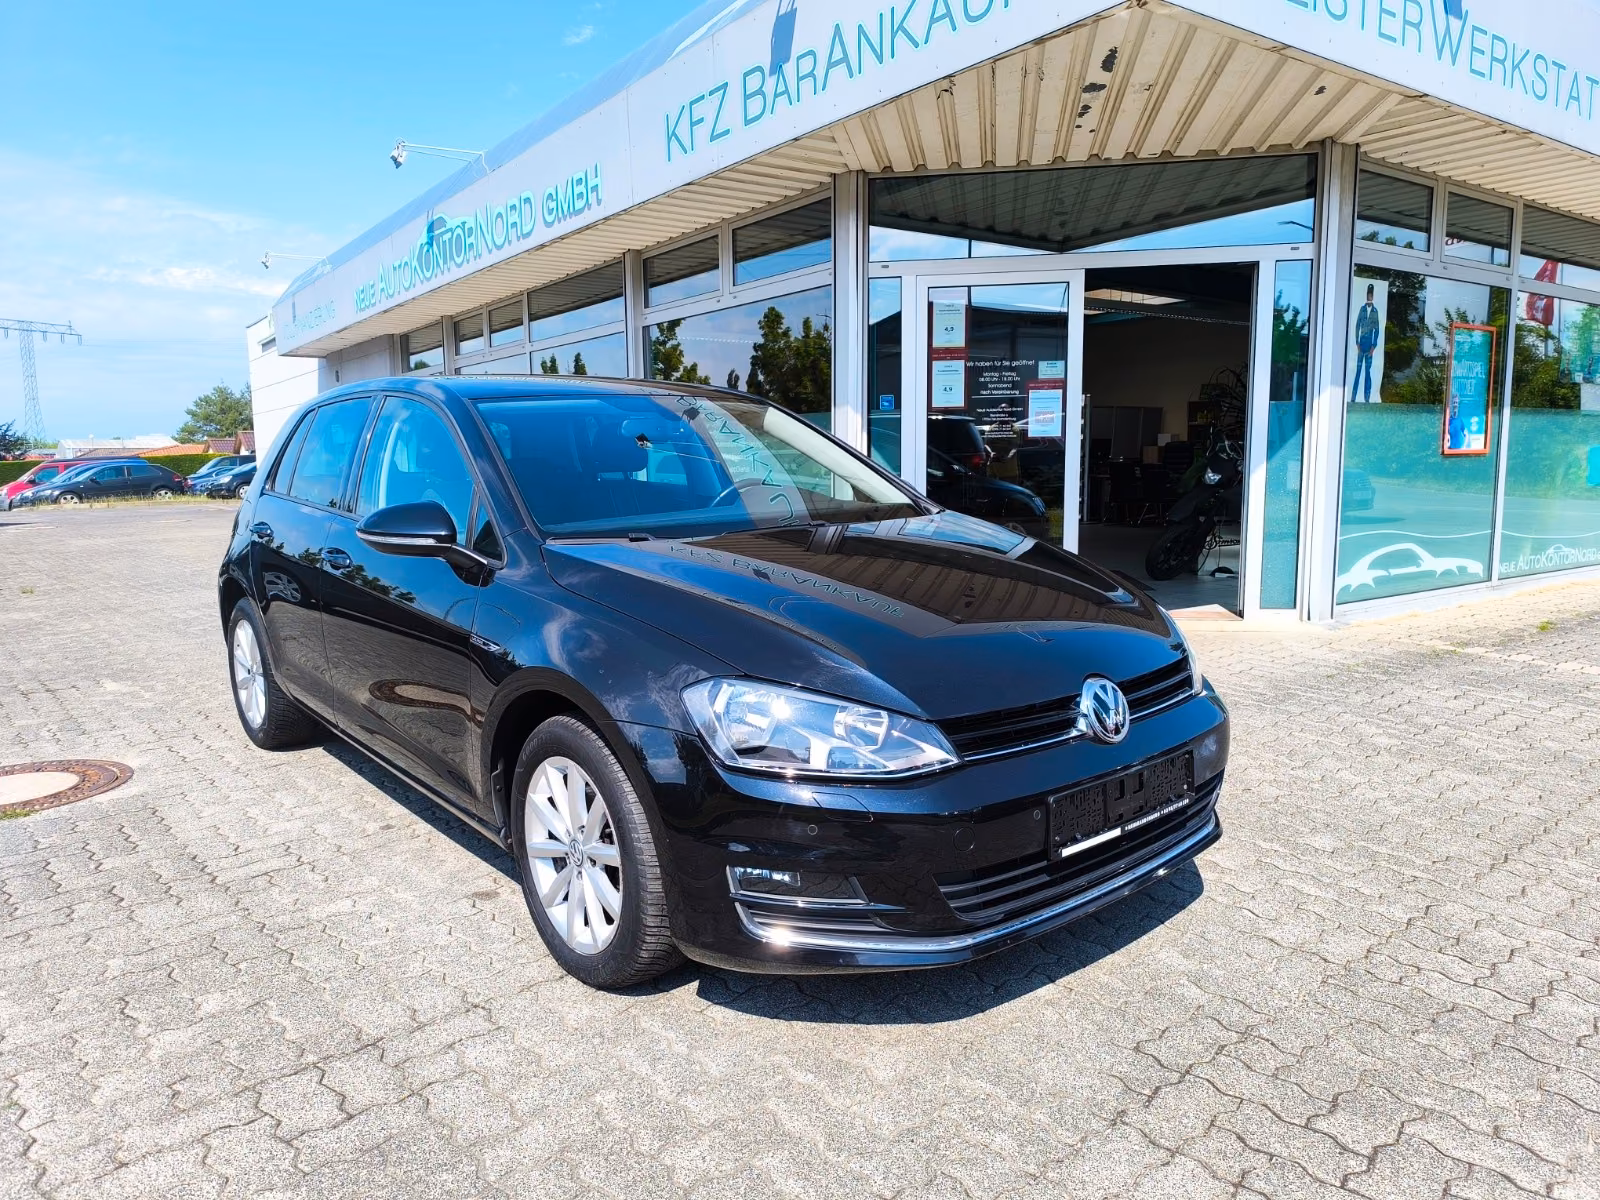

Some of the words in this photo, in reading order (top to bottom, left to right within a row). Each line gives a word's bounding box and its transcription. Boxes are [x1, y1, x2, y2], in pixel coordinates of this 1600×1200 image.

[663, 80, 731, 163] KFZ
[741, 0, 1009, 128] BARANKA
[1285, 0, 1600, 121] TERWERKSTAT
